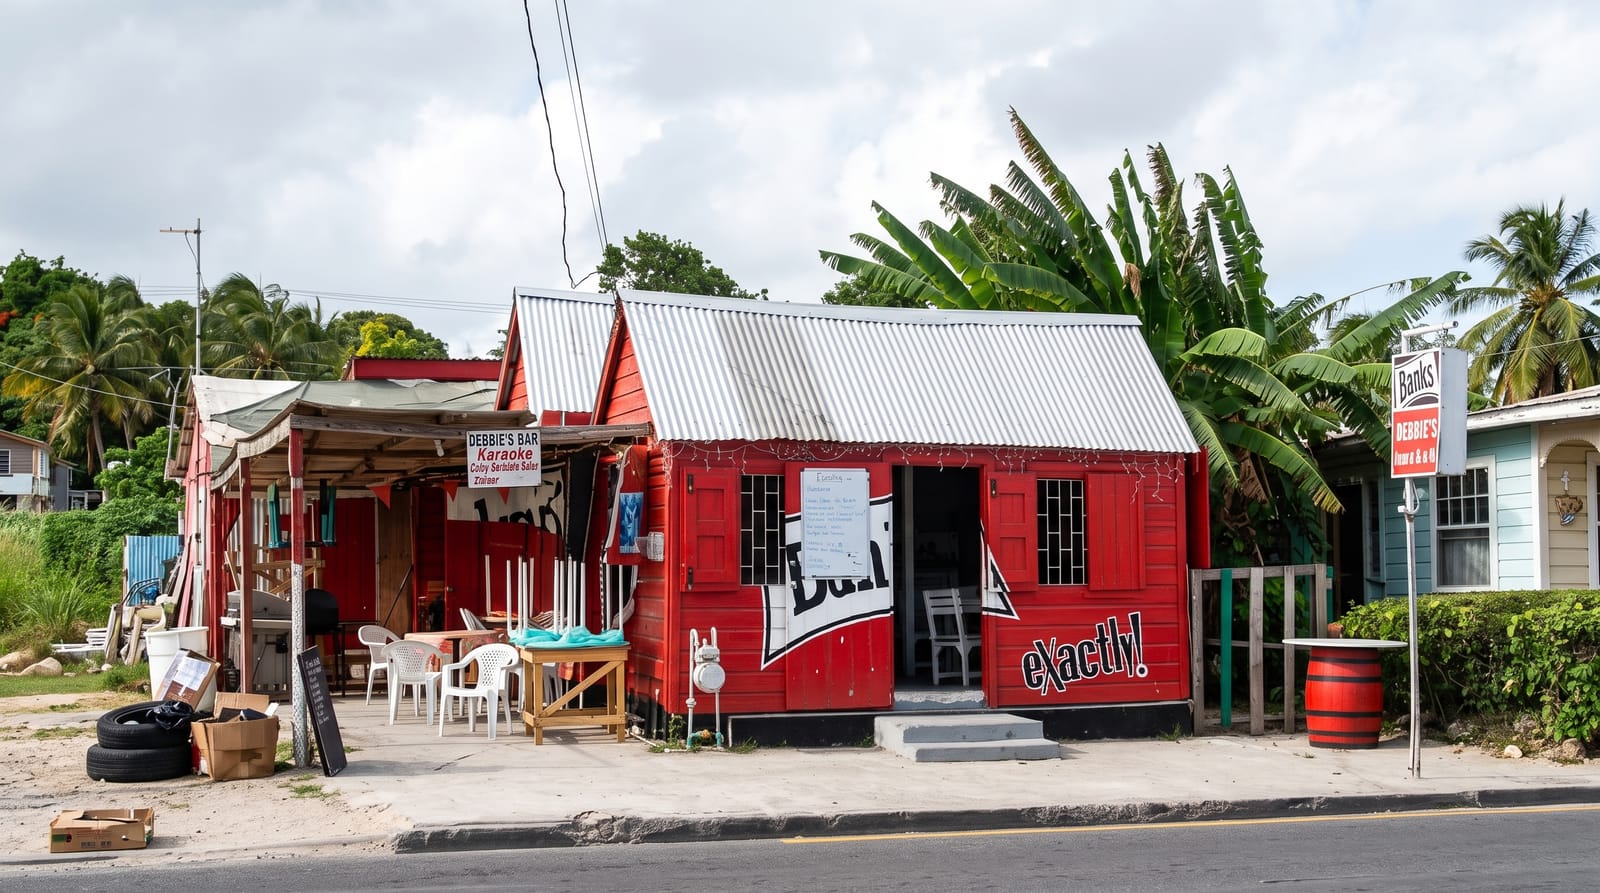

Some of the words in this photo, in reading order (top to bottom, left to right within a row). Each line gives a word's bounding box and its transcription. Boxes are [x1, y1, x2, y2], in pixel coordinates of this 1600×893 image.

[1398, 360, 1434, 403] Banks
[1396, 418, 1437, 441] DEBBIE'S
[469, 433, 514, 447] DEBBIE'S
[517, 432, 538, 446] BAR
[477, 447, 533, 461] Karaoke
